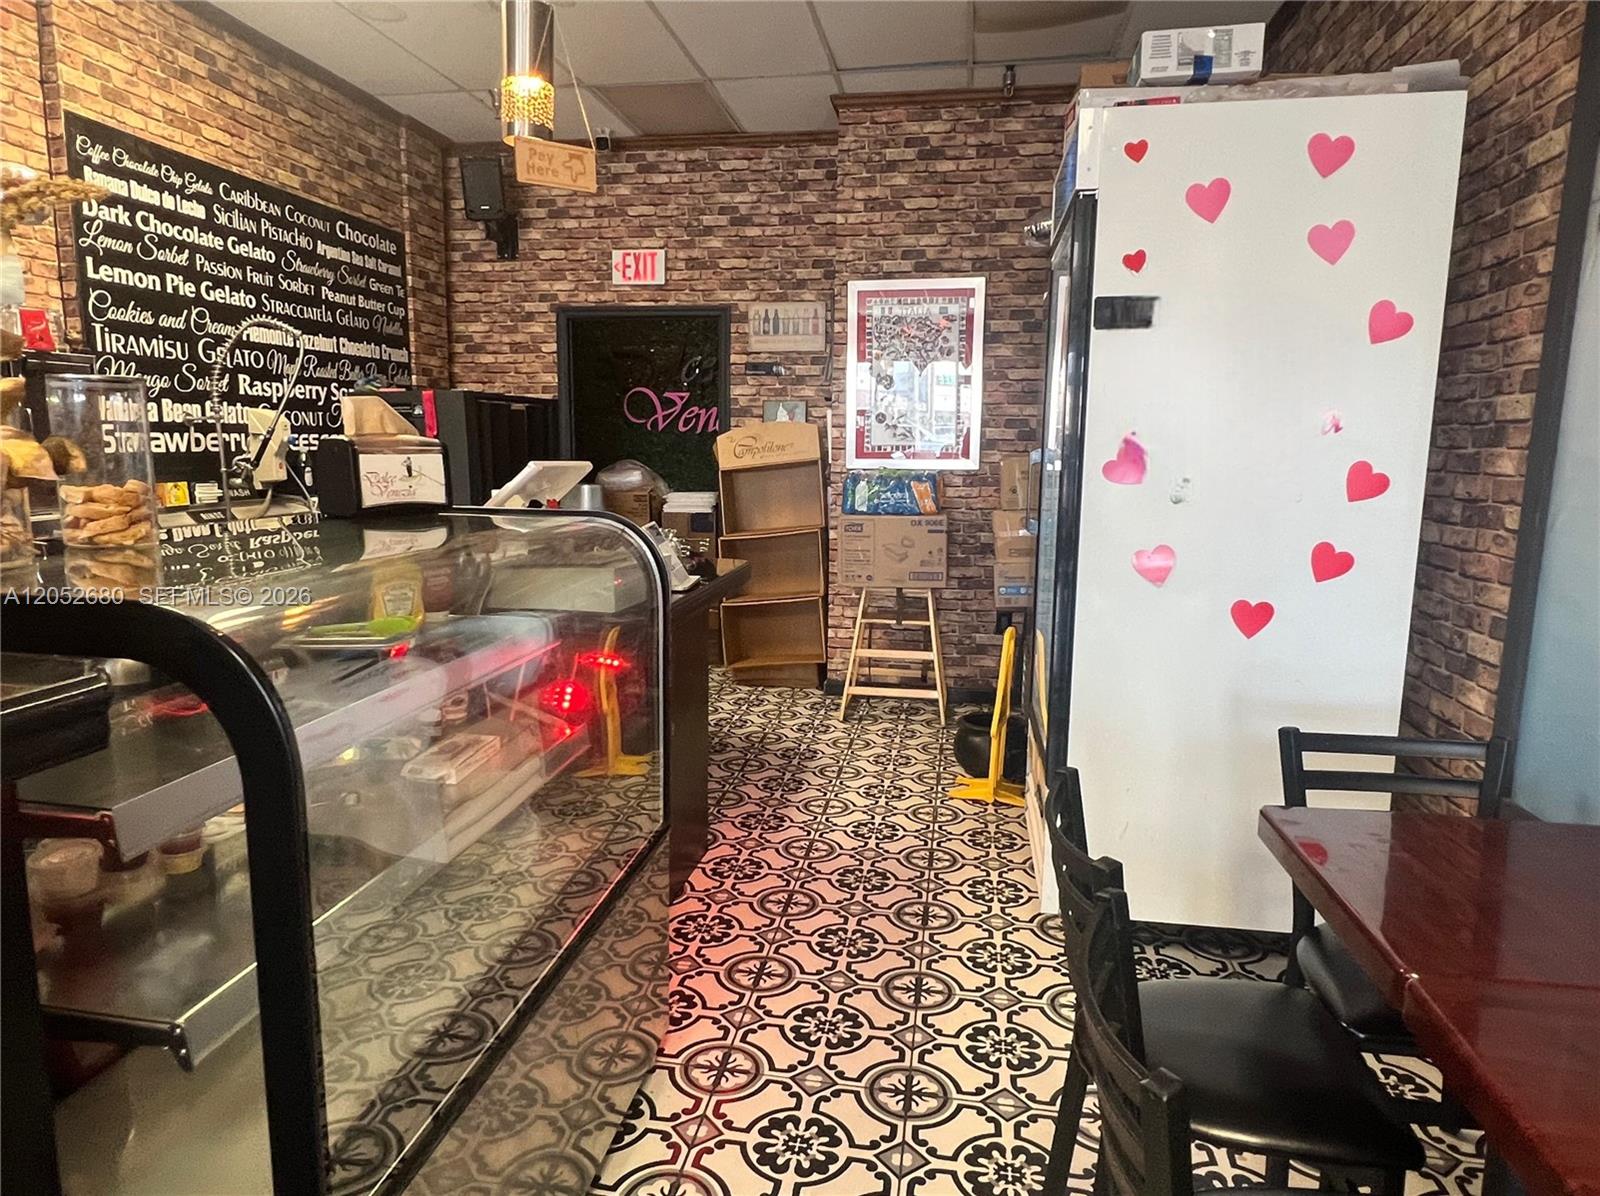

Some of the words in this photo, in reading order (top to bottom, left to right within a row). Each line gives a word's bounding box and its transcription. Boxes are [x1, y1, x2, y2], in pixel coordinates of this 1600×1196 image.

[526, 163, 559, 178] Here
[528, 147, 555, 165] Pay
[76, 134, 110, 164] Coffee
[112, 146, 159, 177] Chocolate
[161, 163, 183, 189] Chip
[185, 172, 213, 195] Gelato
[336, 220, 397, 255] Chocolate
[82, 199, 132, 227] Dark
[135, 210, 224, 251] Chocolate
[227, 236, 276, 264] Gelato
[281, 250, 335, 286] Strawberry
[622, 251, 658, 281] EXIT
[78, 219, 133, 256] Lemon
[136, 233, 190, 266] Sorbet
[321, 286, 356, 306] Peanut
[358, 294, 385, 313] Butter
[387, 302, 405, 321] Cup
[85, 256, 162, 292] Lemon
[165, 272, 197, 298] Pie
[200, 280, 256, 309] Gelato
[88, 287, 155, 325] Cookies
[158, 309, 189, 331] and
[339, 336, 381, 360] Chocolate
[381, 343, 409, 364] Crunch
[238, 373, 327, 406] Raspberry
